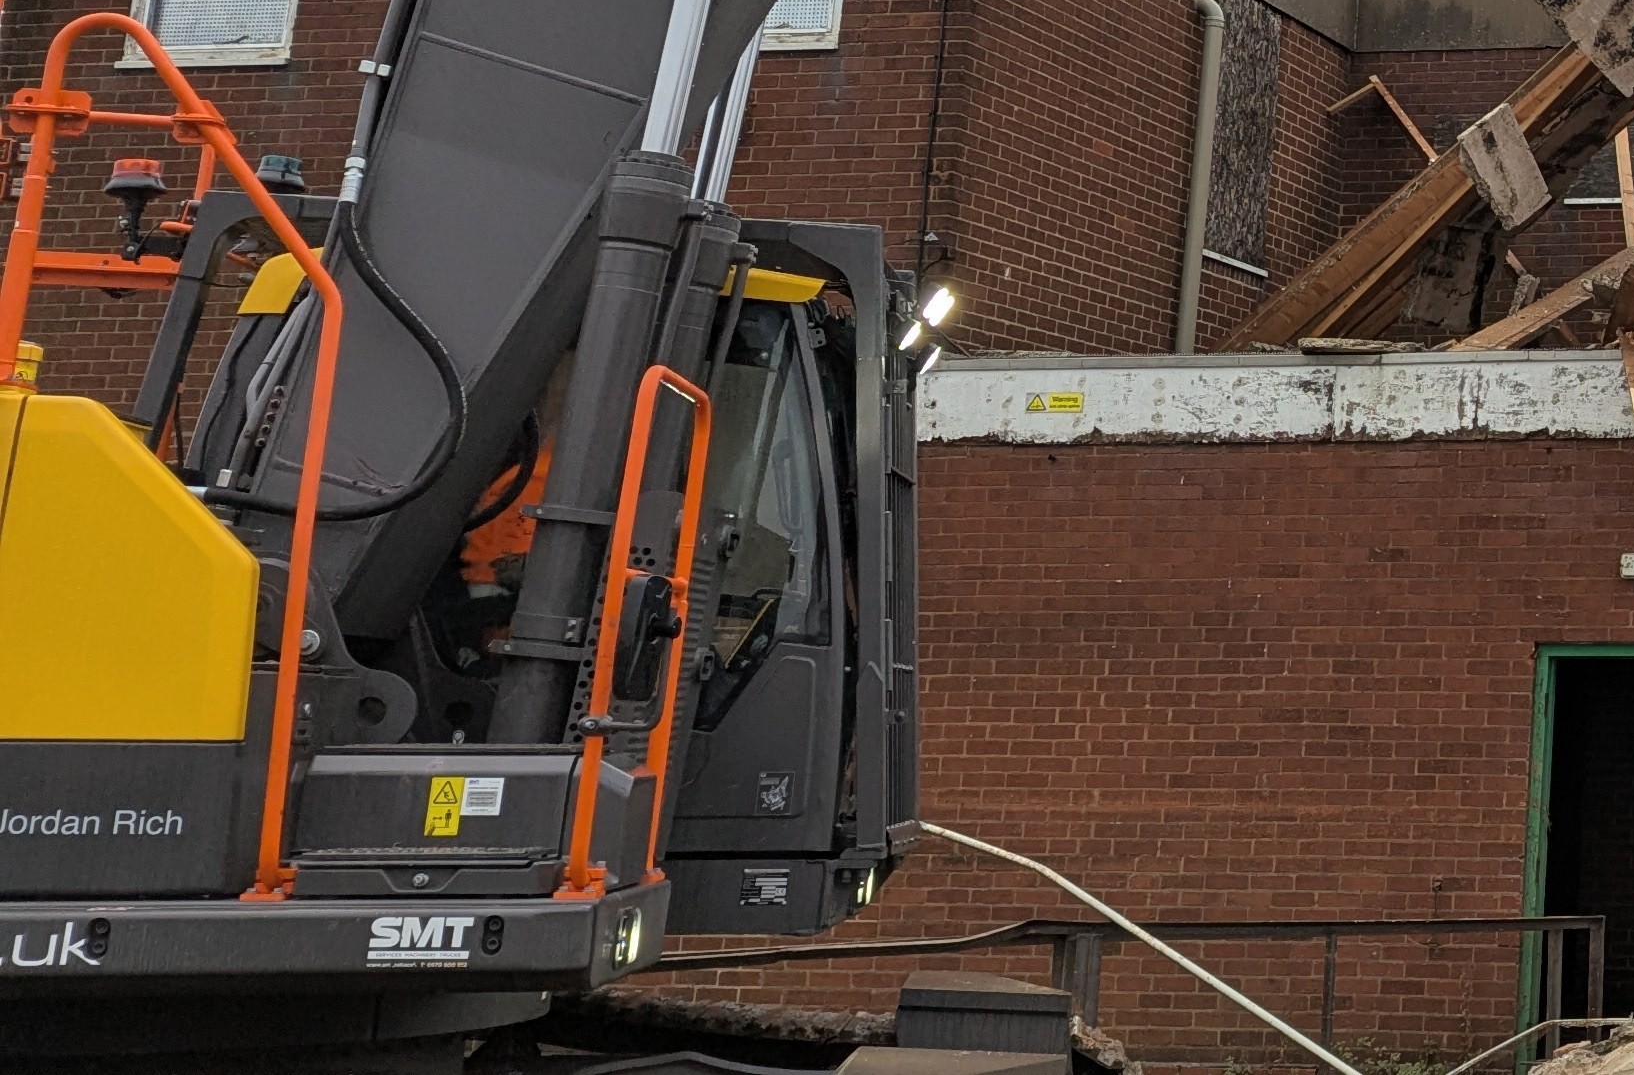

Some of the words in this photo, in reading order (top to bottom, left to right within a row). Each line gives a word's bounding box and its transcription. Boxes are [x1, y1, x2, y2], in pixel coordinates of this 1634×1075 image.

[0, 809, 100, 835] Jordan
[112, 809, 183, 835] Rich
[369, 917, 475, 948] SMT
